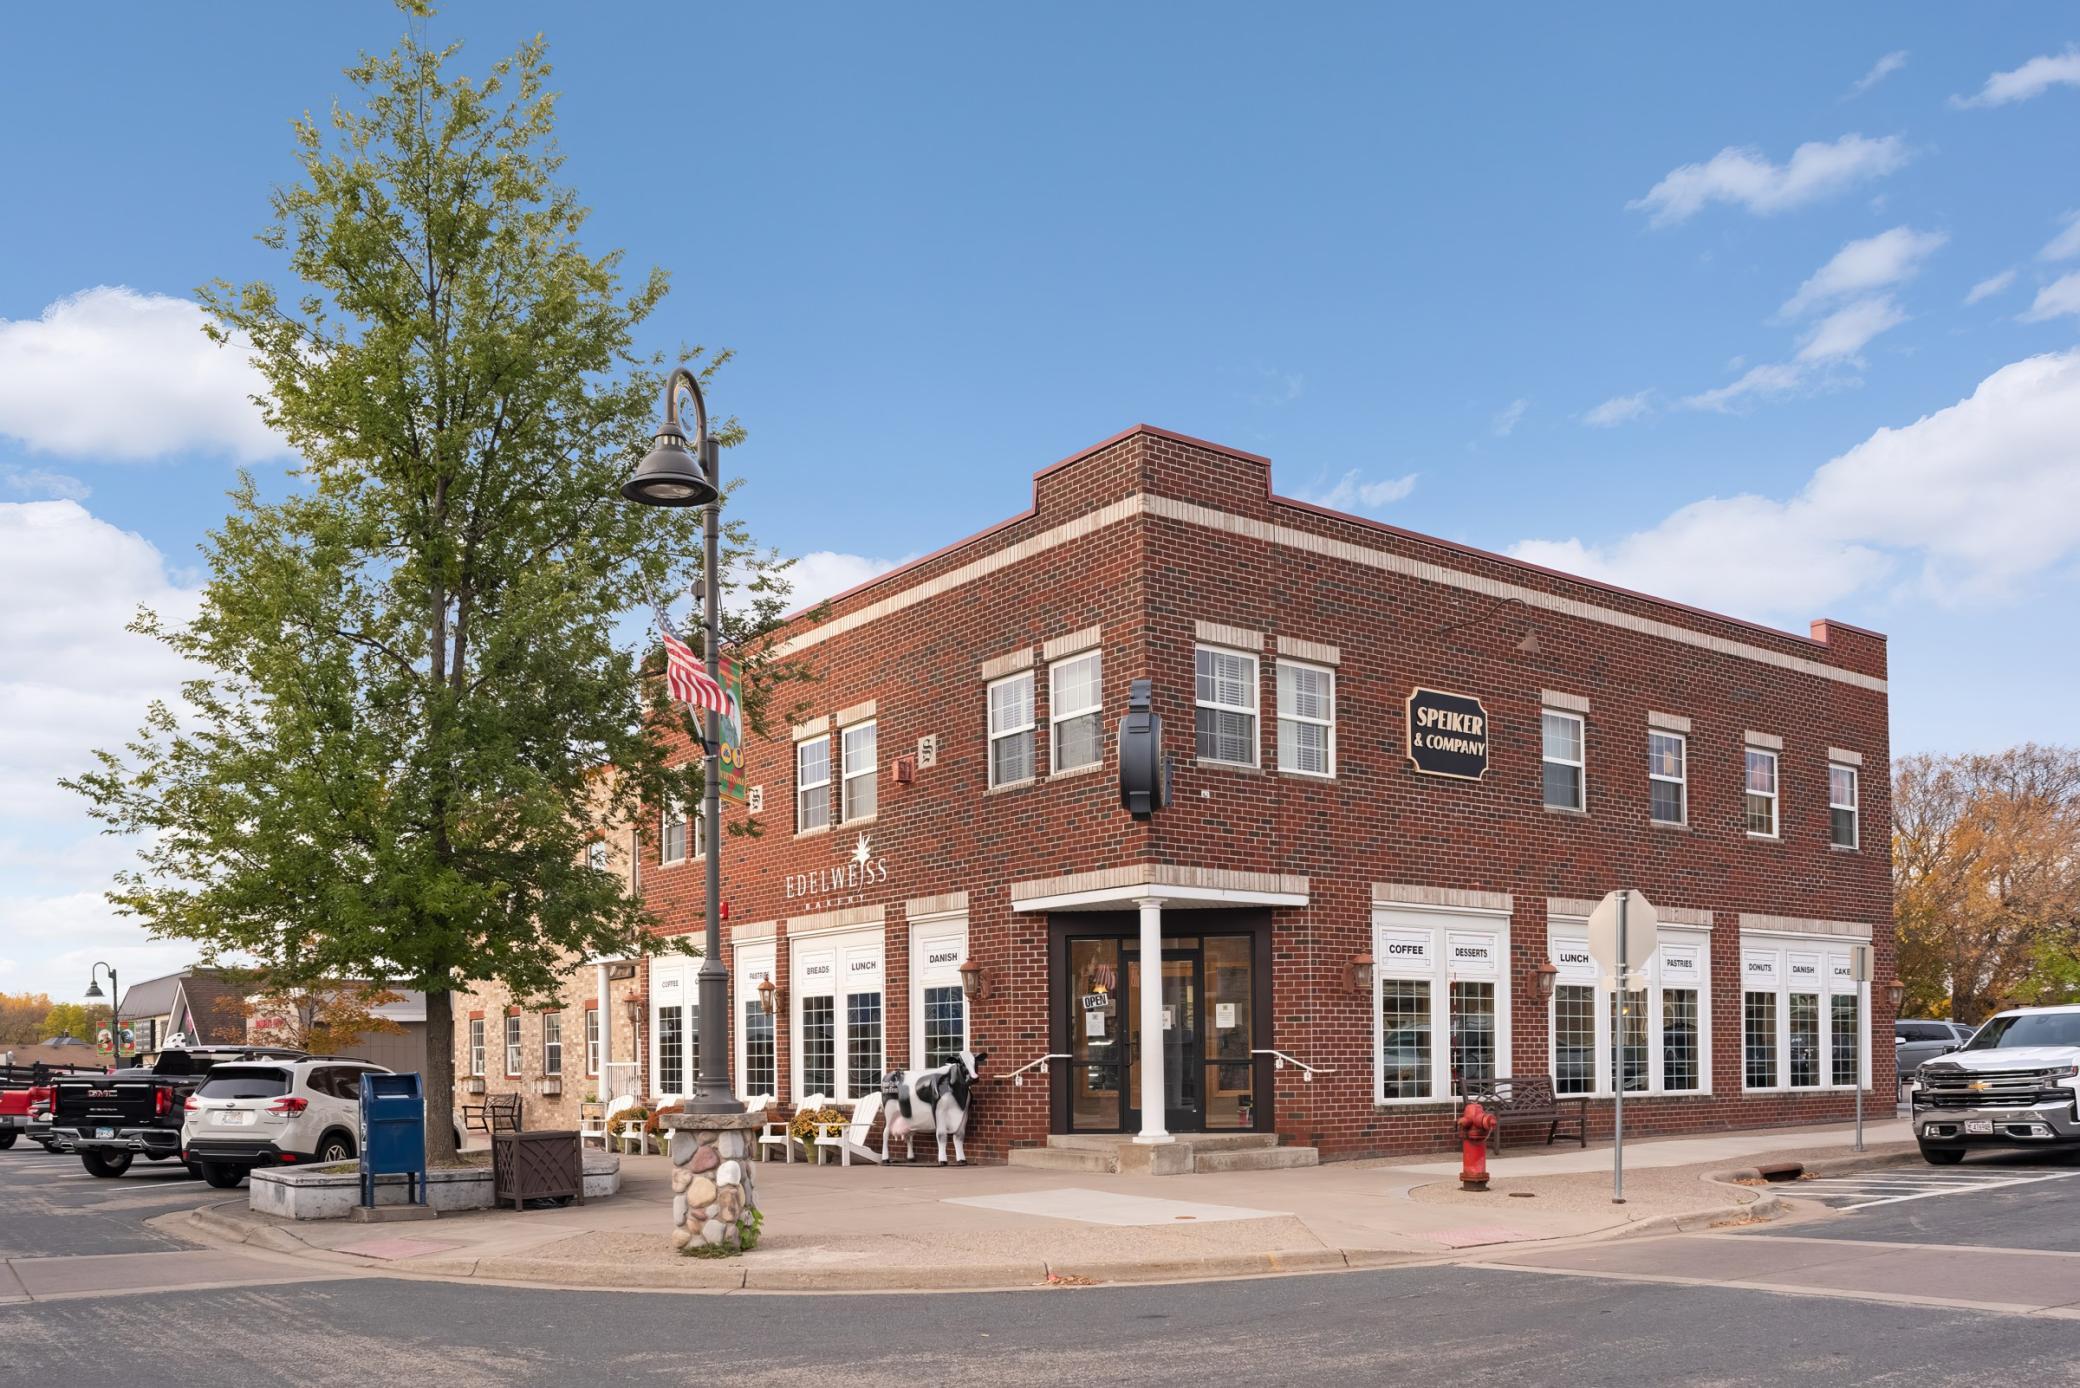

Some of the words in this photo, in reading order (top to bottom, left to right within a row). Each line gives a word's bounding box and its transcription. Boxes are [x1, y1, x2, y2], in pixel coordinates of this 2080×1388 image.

[1416, 706, 1483, 736] SPEIKER
[1414, 732, 1423, 747] &
[1426, 734, 1485, 756] COMPANY
[786, 858, 887, 899] EDELWEISS
[805, 894, 864, 911] BAKERY
[1389, 944, 1424, 955] COFFEE
[1455, 947, 1488, 958] DESSERTS
[929, 952, 958, 964] DANISH
[1560, 953, 1589, 963] LUNCH
[1666, 959, 1693, 968] PASTRIES
[806, 965, 830, 975] BREADS
[851, 960, 877, 971] LUNCH
[1748, 963, 1772, 972] DONUTS
[1792, 965, 1815, 974] DANISH
[1834, 967, 1851, 975] CAKE
[662, 980, 679, 988] COFFEE
[1084, 995, 1107, 1007] OPEN
[88, 1089, 118, 1098] GMC
